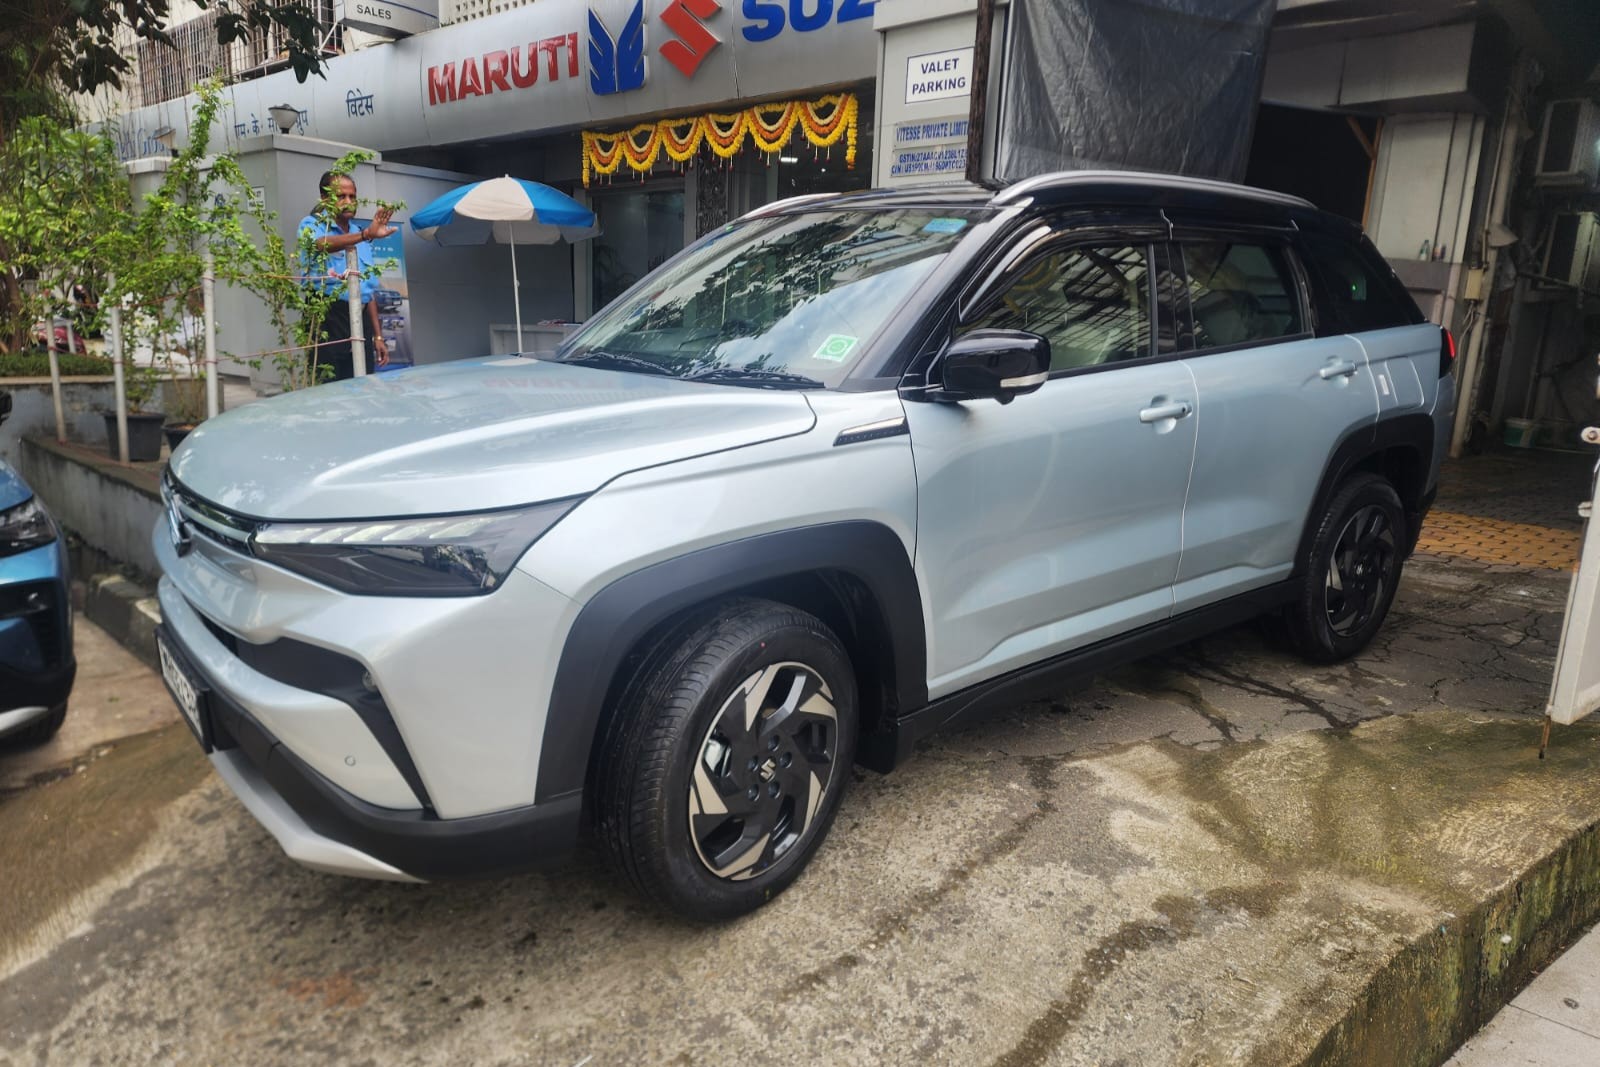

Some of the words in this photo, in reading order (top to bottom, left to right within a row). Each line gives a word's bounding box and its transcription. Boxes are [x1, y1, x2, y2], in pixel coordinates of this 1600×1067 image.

[356, 4, 392, 20] SALES
[427, 31, 580, 107] MARUTI
[921, 57, 960, 74] VALET
[912, 76, 966, 95] PARKING
[345, 88, 374, 117] विटेस
[896, 125, 921, 142] VITESSE
[921, 120, 949, 139] PRIVATE
[949, 119, 969, 137] LIMIT
